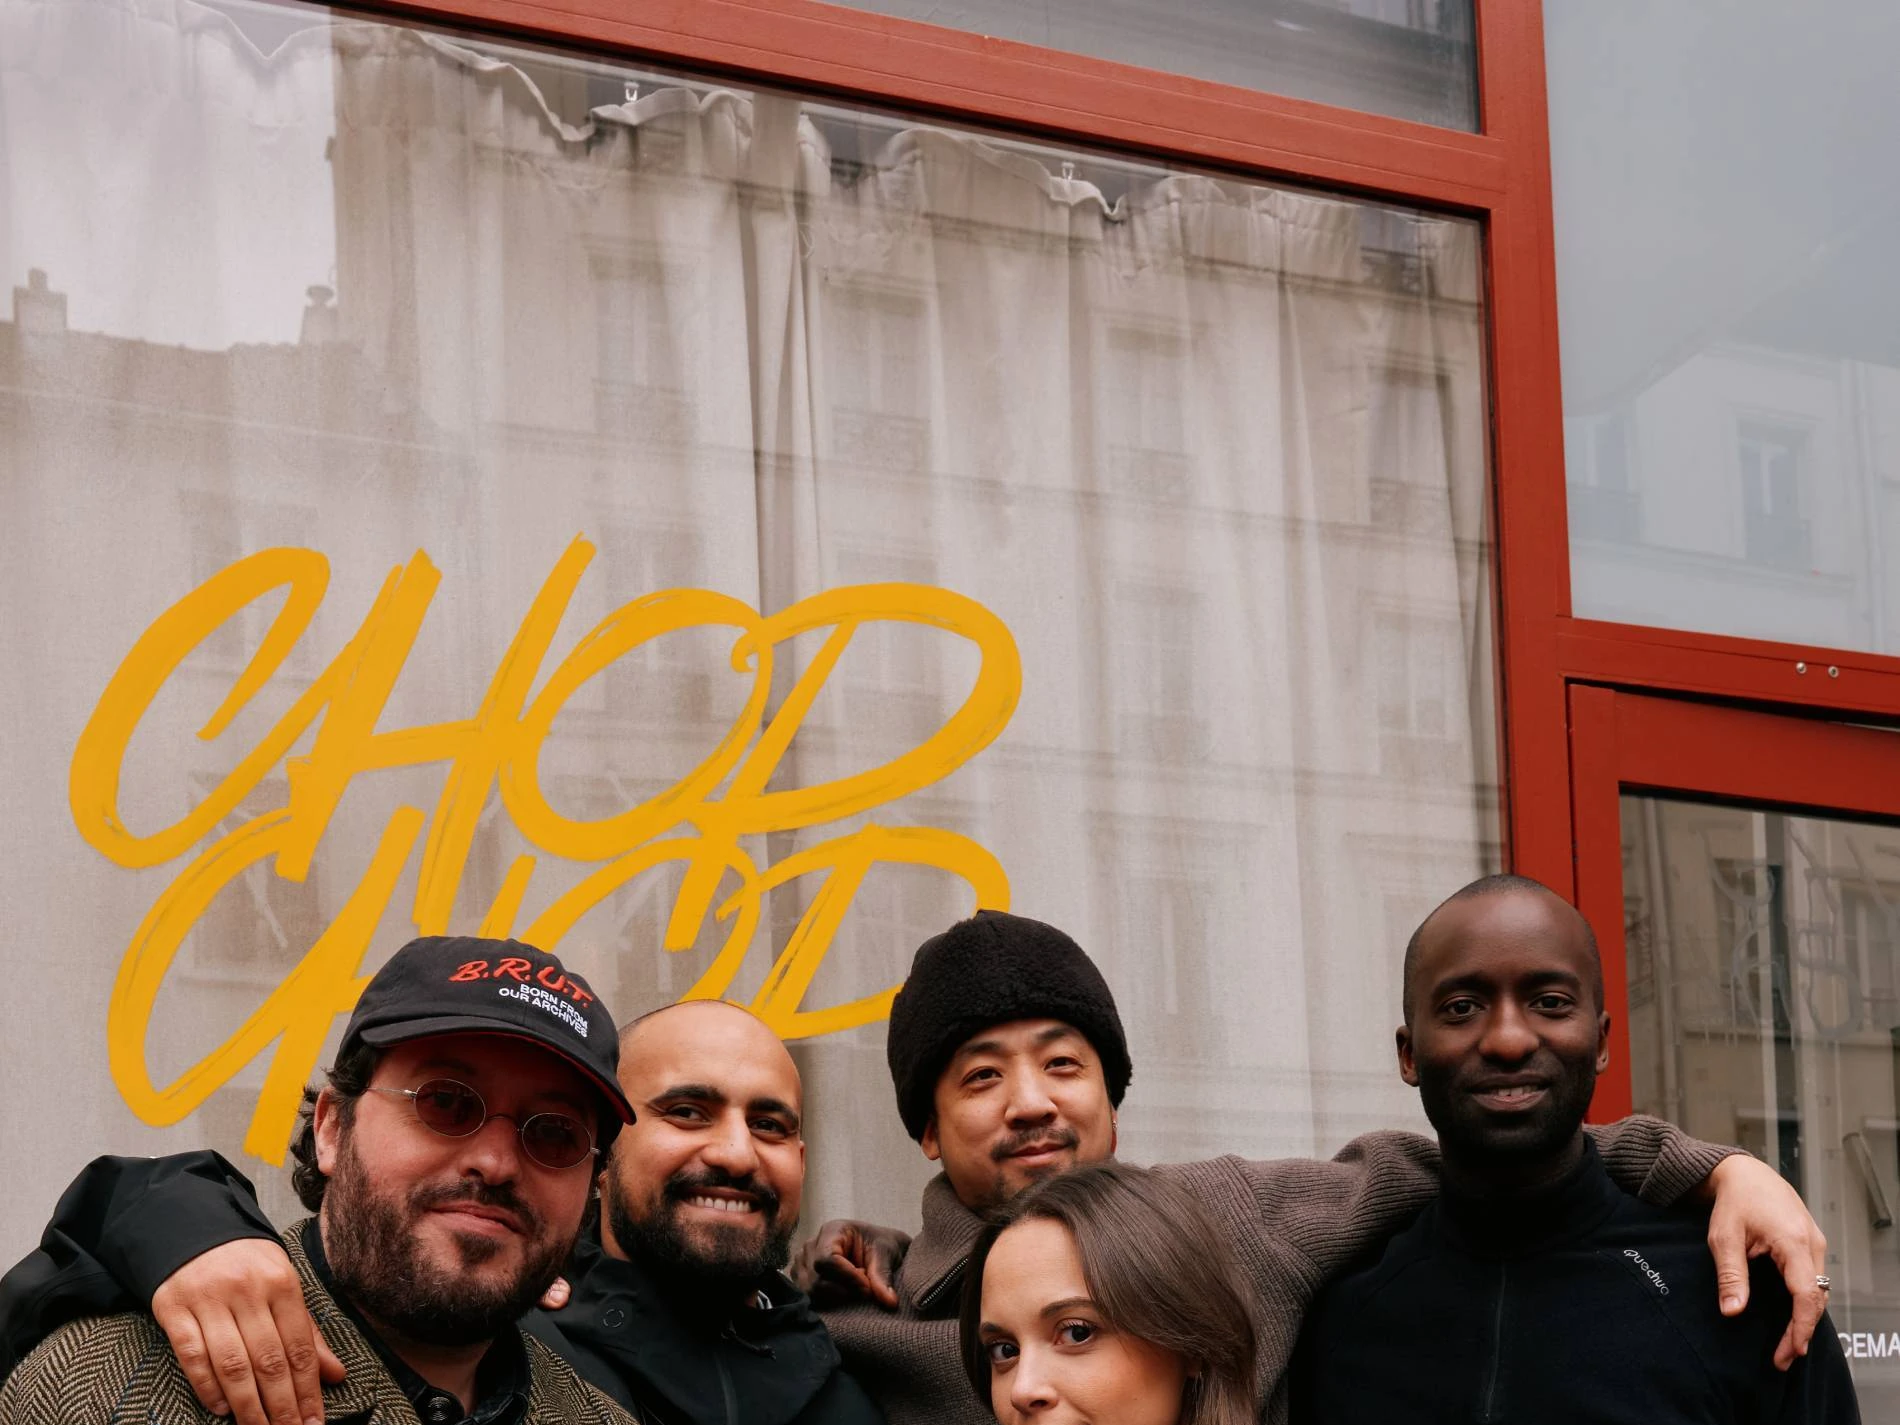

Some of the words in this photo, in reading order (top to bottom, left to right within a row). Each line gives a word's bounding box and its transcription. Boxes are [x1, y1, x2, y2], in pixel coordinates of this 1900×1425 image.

[69, 532, 1022, 951] CHOP
[499, 987, 529, 1002] OUR
[532, 997, 588, 1038] ARCHIVES
[520, 984, 558, 1005] BORN
[560, 1000, 588, 1029] FROM
